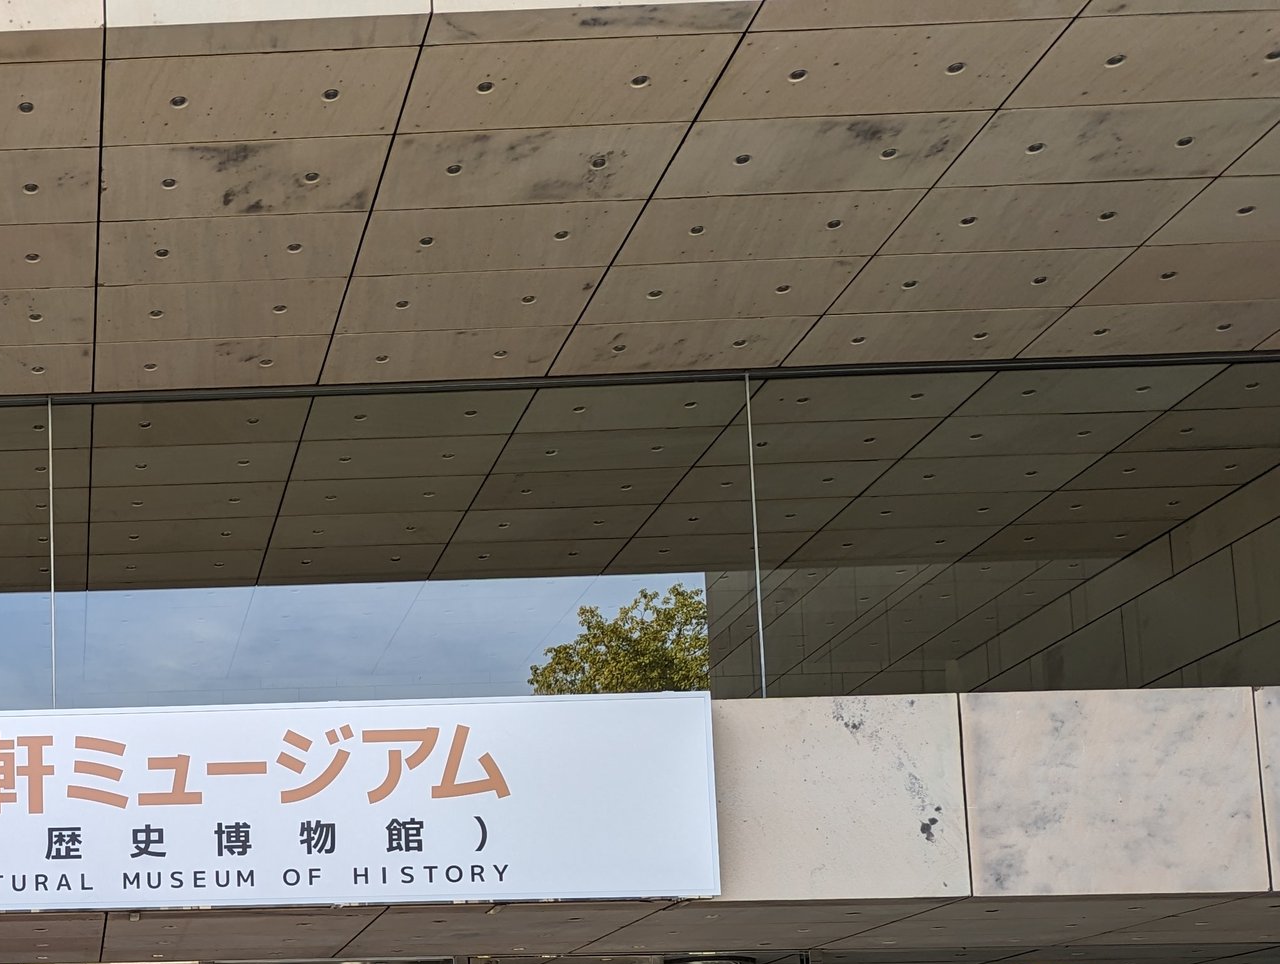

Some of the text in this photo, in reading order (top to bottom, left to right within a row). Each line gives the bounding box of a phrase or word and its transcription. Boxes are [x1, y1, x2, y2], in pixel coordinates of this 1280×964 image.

[123, 869, 256, 890] MUSEUM
[283, 868, 323, 887] OF
[353, 864, 511, 885] HISTORY
